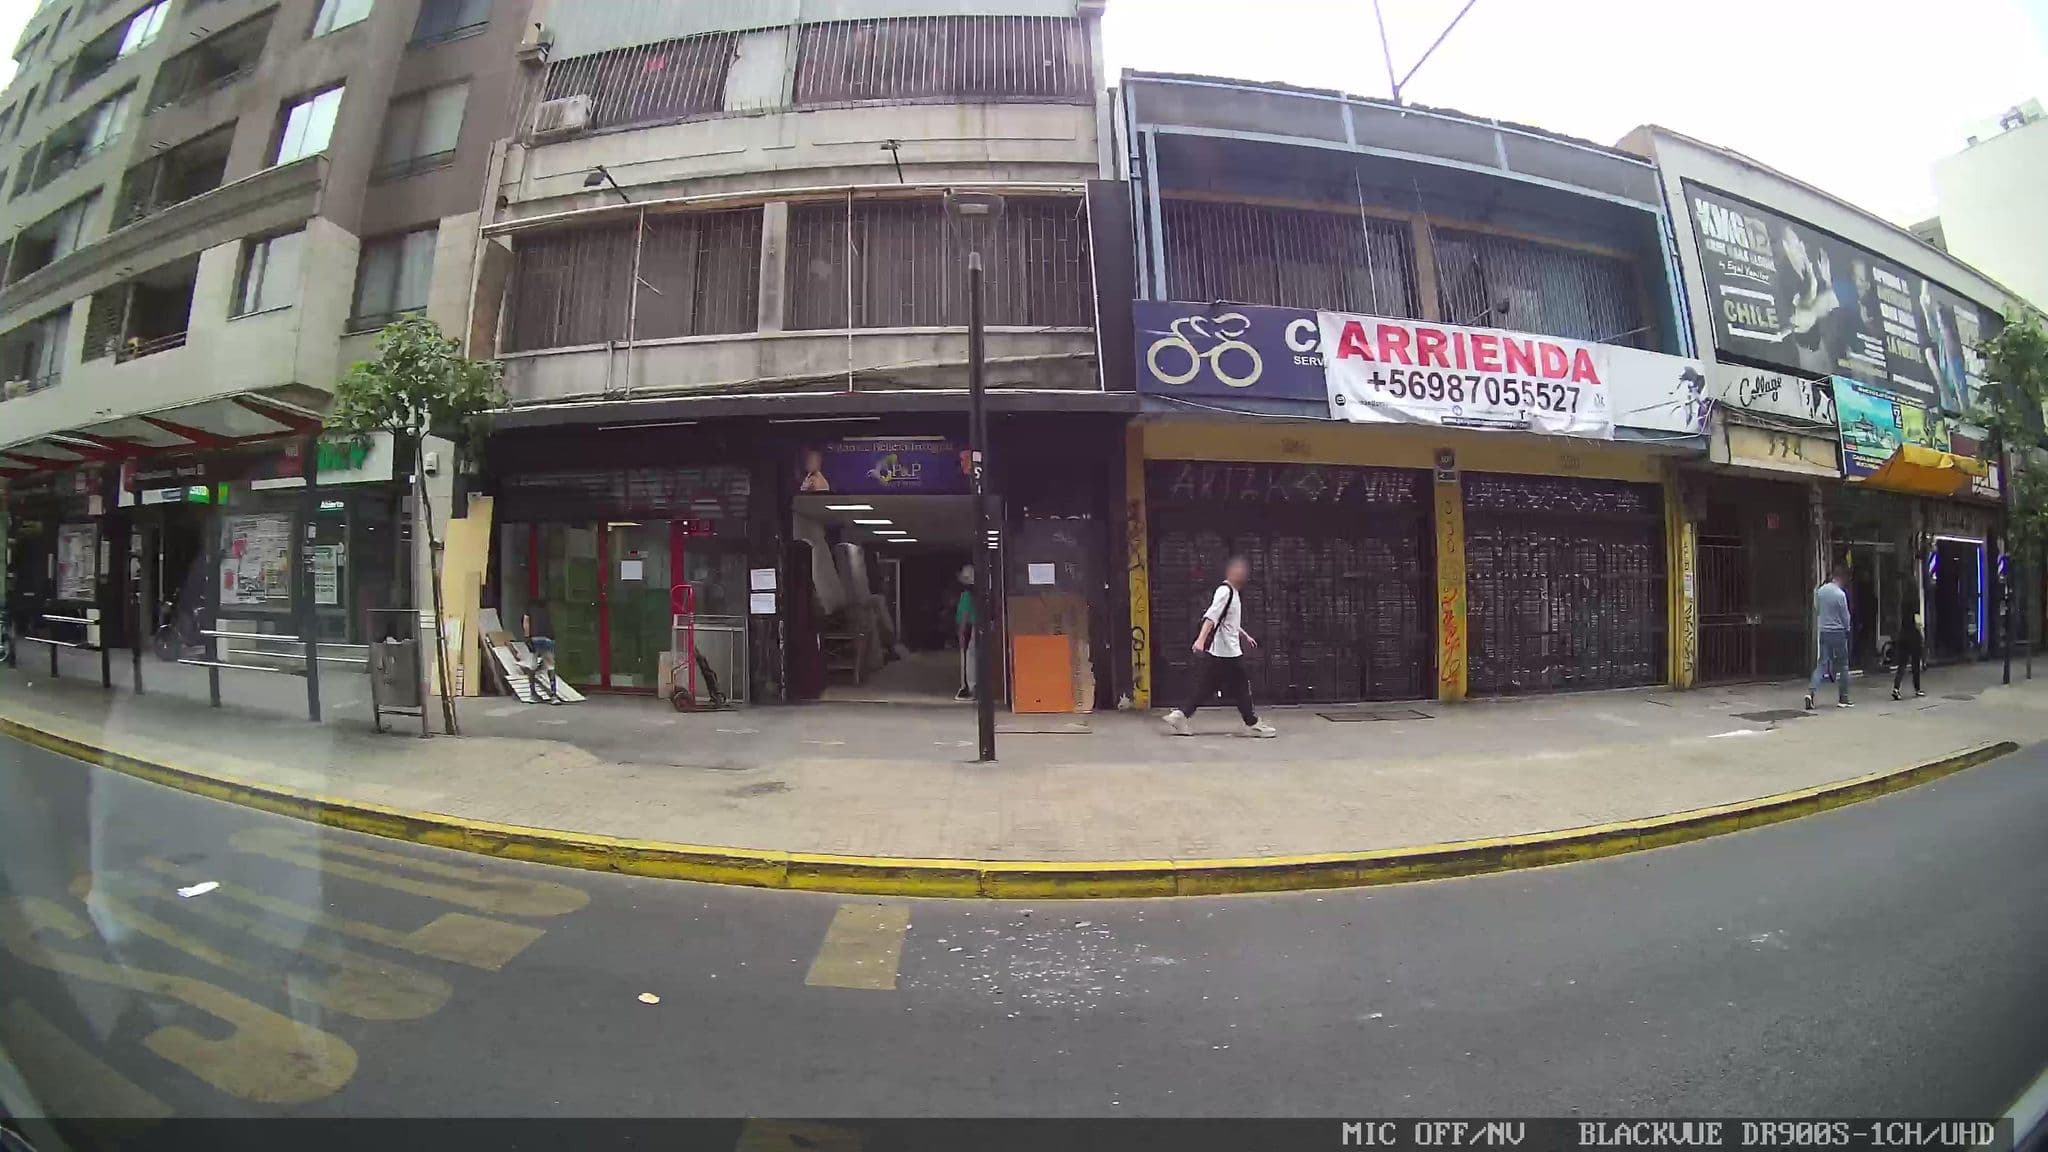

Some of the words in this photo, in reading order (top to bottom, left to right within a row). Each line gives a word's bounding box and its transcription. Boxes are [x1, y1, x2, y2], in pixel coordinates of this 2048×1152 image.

[1723, 299, 1780, 329] CHILE
[1337, 320, 1601, 385] ARRIENDA
[1367, 370, 1581, 413] +56987055527
